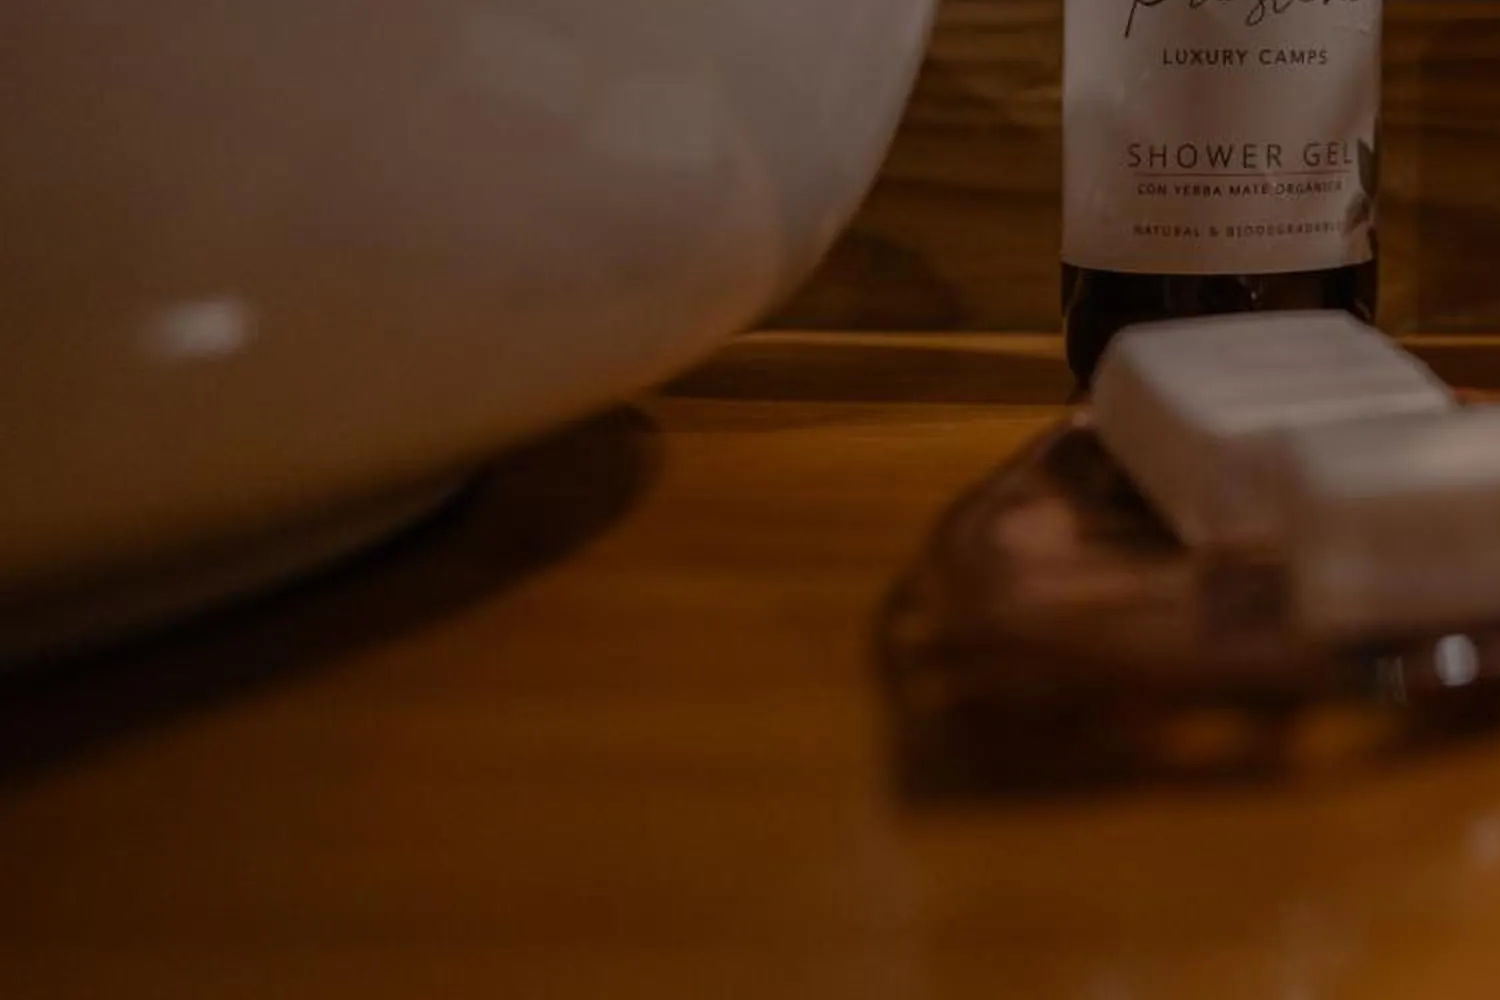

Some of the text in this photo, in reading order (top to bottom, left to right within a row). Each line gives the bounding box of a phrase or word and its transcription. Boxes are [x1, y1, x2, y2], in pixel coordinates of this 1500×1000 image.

[1163, 47, 1329, 66] LUXURY CAMPS
[1127, 141, 1353, 169] SHOWER GEL
[1137, 182, 1167, 196] CON
[1174, 183, 1222, 197] YERBA
[1229, 182, 1268, 197] MATE
[1133, 223, 1200, 238] NATURAL
[1208, 225, 1220, 238] &
